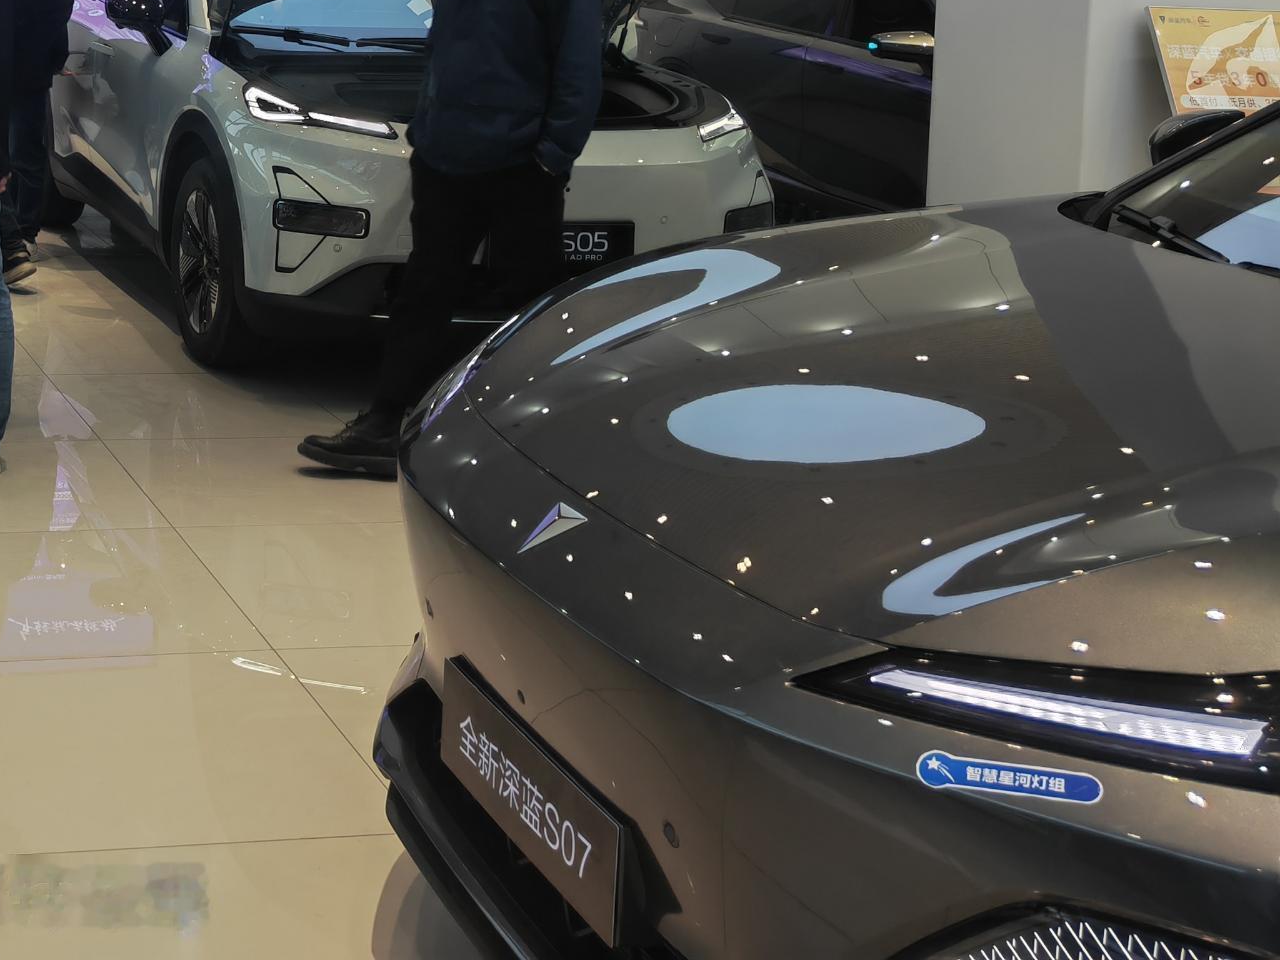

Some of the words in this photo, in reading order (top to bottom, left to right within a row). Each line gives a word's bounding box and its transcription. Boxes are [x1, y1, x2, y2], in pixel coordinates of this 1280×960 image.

[562, 232, 608, 252] S05
[965, 766, 1066, 793] 智慧星河灯组
[459, 716, 592, 879] 全新深蓝S07
